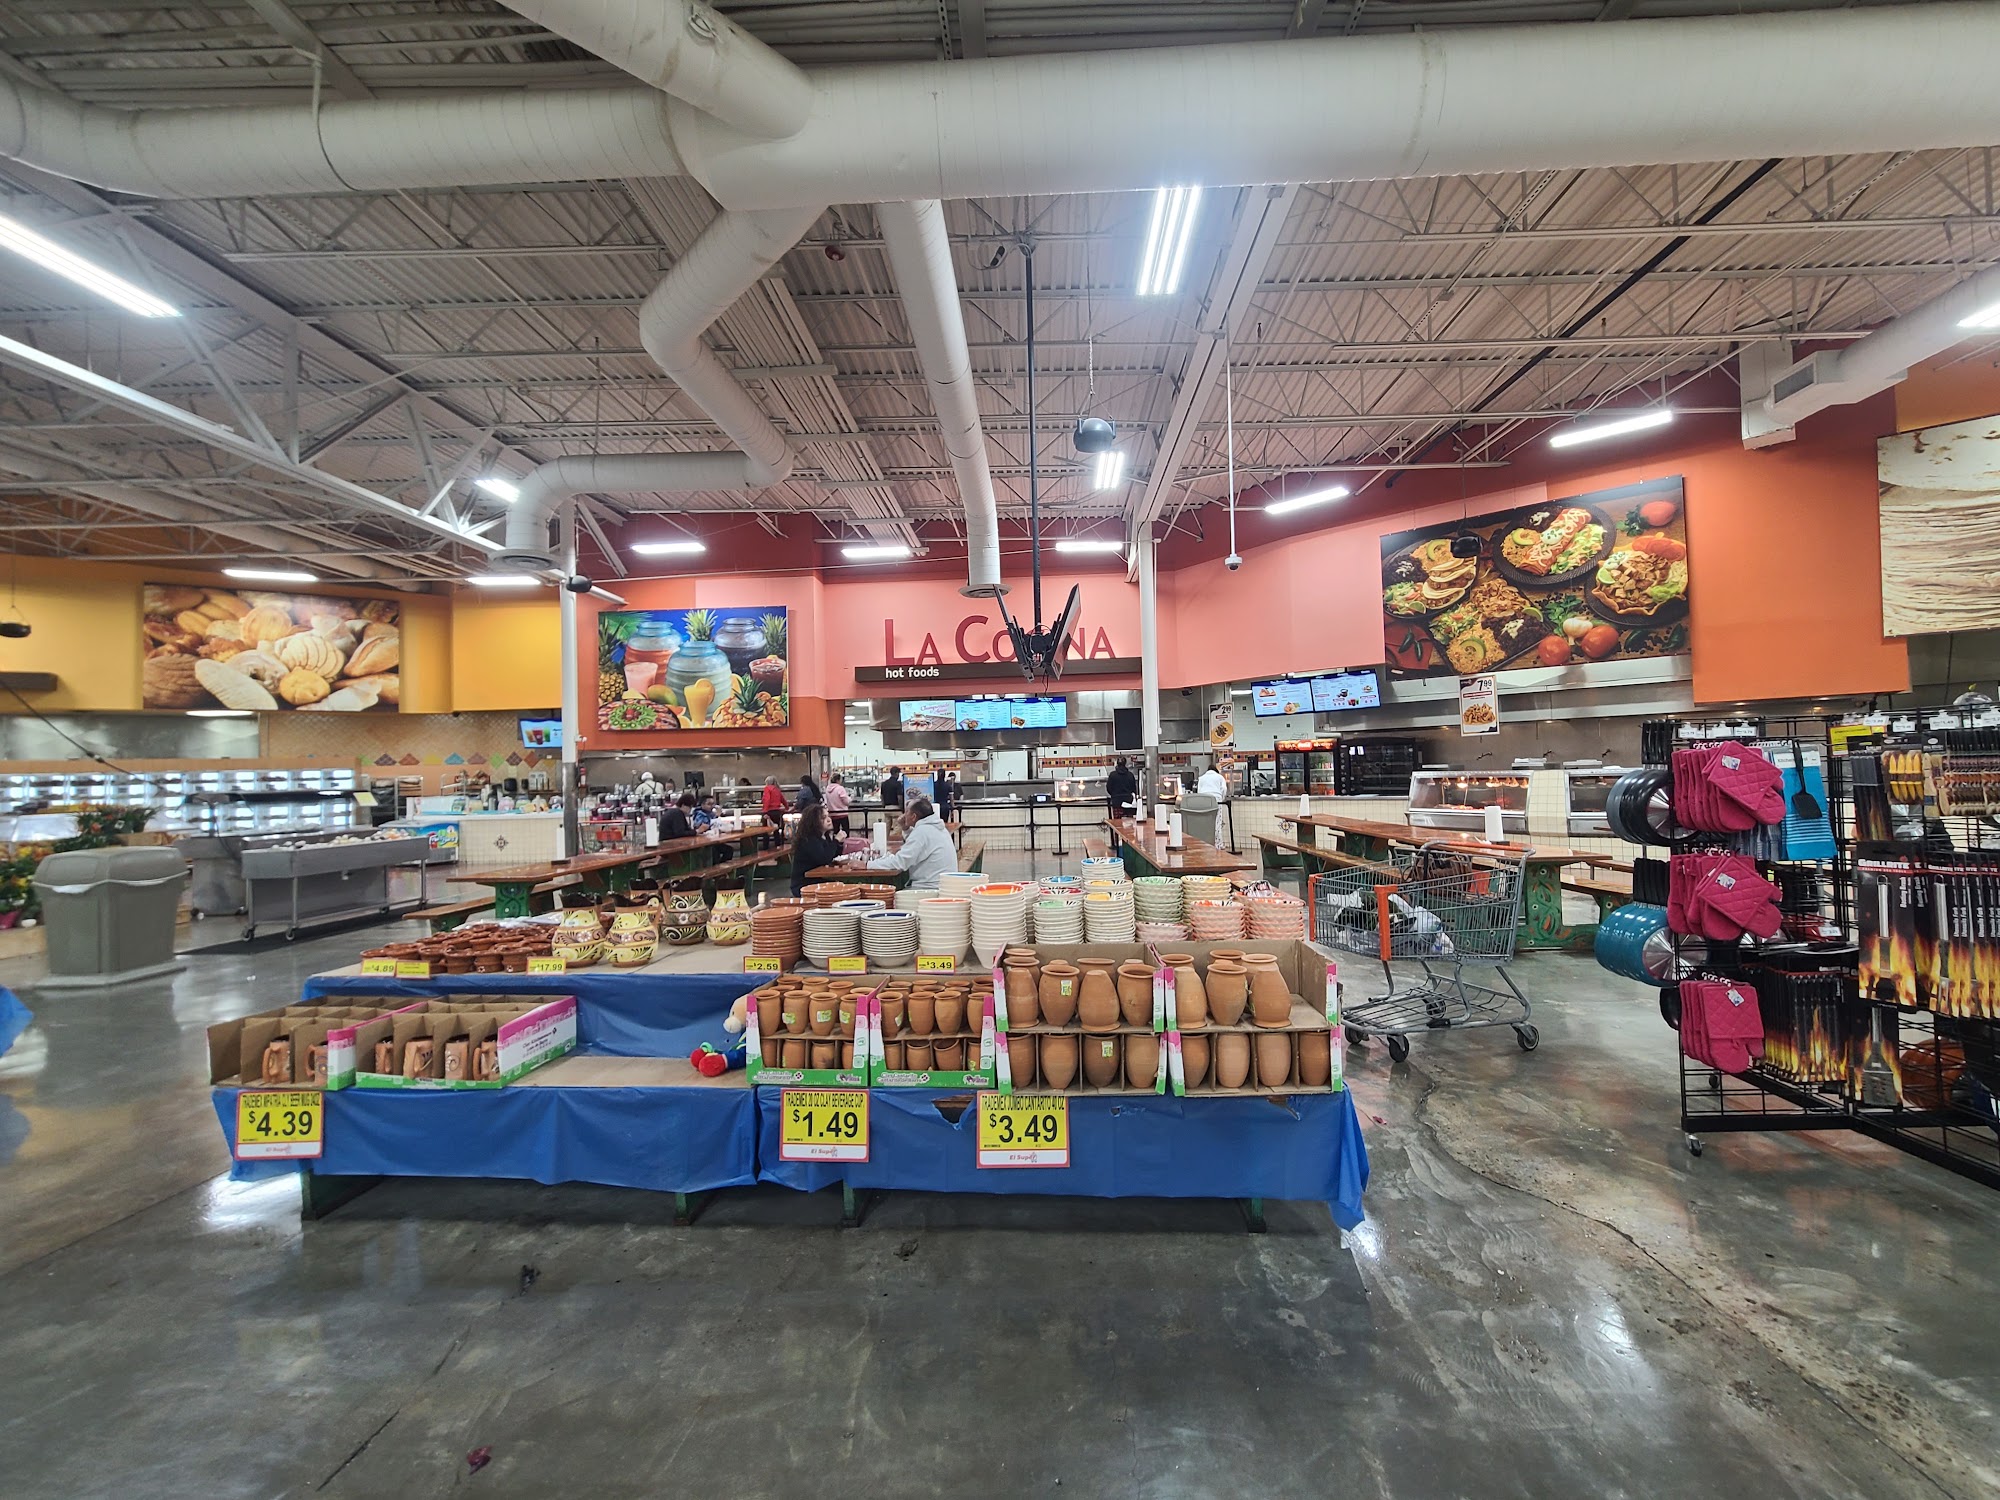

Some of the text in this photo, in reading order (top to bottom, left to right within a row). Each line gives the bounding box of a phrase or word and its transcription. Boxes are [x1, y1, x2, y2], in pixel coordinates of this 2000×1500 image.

[955, 615, 1116, 663] CONA
[885, 666, 940, 679] hot foods
[786, 1092, 807, 1107] TRADEMEX
[814, 1092, 819, 1107] OZ
[820, 1092, 831, 1107] CLAY
[832, 1093, 854, 1108] BEVERAGE
[981, 1095, 1006, 1110] TRADEMEX
[1025, 1095, 1051, 1110] CANTARITO
[248, 1110, 313, 1136] $4.39
[793, 1109, 858, 1138] $1.49
[989, 1113, 1058, 1143] $3.49
